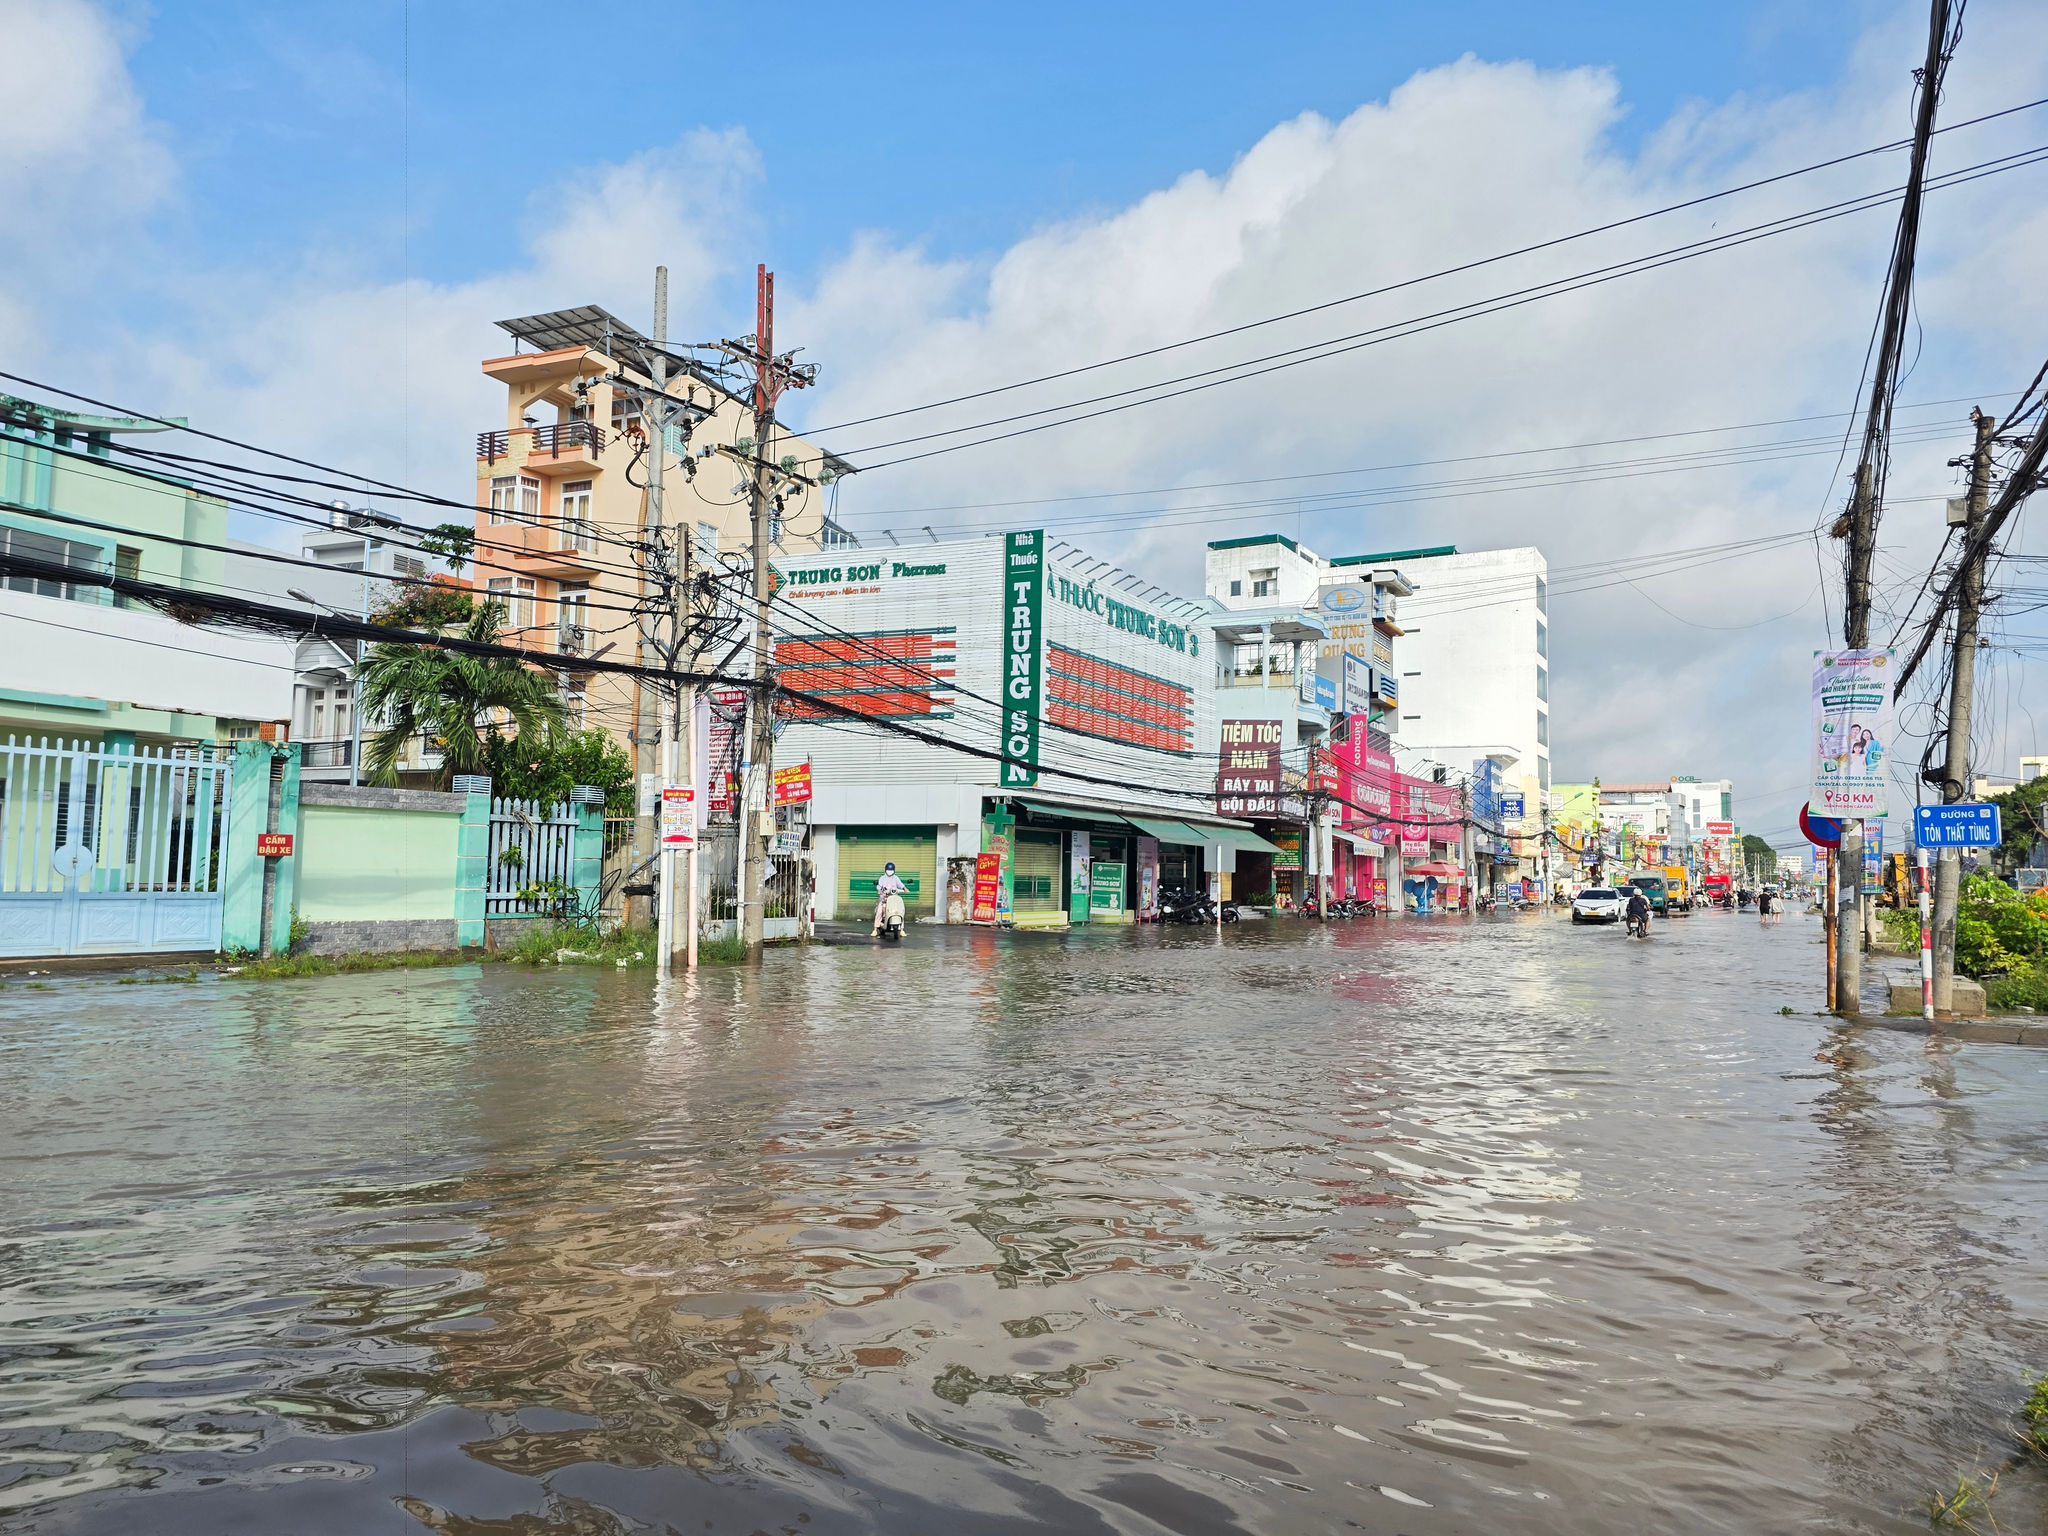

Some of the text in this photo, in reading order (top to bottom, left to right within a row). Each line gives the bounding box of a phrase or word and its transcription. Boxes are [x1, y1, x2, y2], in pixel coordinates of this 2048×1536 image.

[1015, 533, 1034, 547] Nhà
[1010, 550, 1039, 566] Thuốc
[788, 562, 946, 586] TRUNG SƠN Pharma
[1058, 578, 1105, 617] THUỐC
[1105, 597, 1156, 641] TRUNG
[1158, 620, 1187, 654] SƠN
[1190, 634, 1199, 657] 3
[1328, 624, 1366, 640] RUNG
[1009, 581, 1033, 700] TRUNG
[1322, 643, 1366, 659] QUANG
[1828, 675, 1853, 687] Thanh
[1222, 721, 1281, 747] TIỆM TÓC
[1354, 720, 1364, 766] concung
[1230, 750, 1269, 769] NAM
[1223, 777, 1274, 793] RÁY TAI
[1221, 796, 1244, 814] GỘI
[1246, 796, 1276, 813] ĐẦU
[1835, 793, 1874, 803] 50 KM
[1941, 810, 1975, 819] ĐƯỜNG
[1924, 821, 1991, 842] TÔN THẤT TÙNG
[266, 835, 286, 845] CẤM
[258, 845, 292, 856] ĐẬU XE
[1496, 889, 1507, 897] 25
